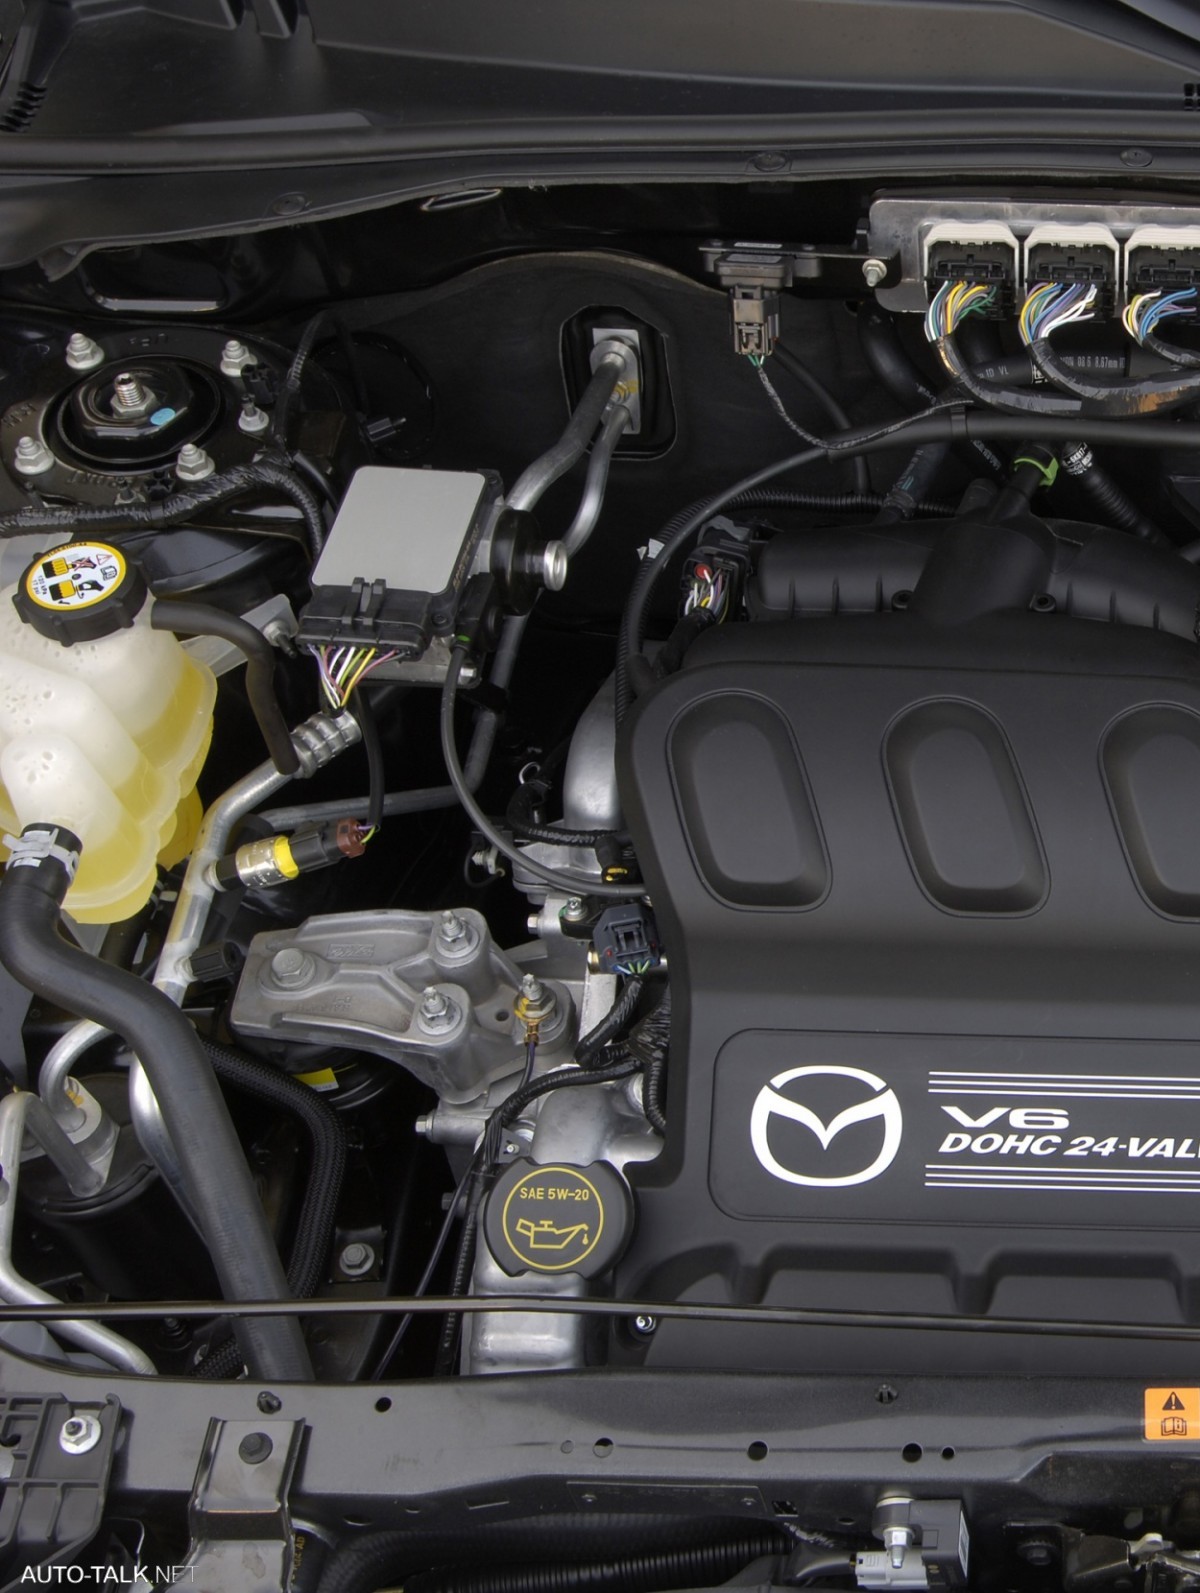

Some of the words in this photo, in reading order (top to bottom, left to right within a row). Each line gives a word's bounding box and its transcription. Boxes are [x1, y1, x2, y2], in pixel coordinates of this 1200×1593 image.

[941, 1106, 1070, 1130] V6
[938, 1133, 1062, 1156] DOHC
[520, 1187, 545, 1200] SAE
[547, 1188, 589, 1201] 5W-20
